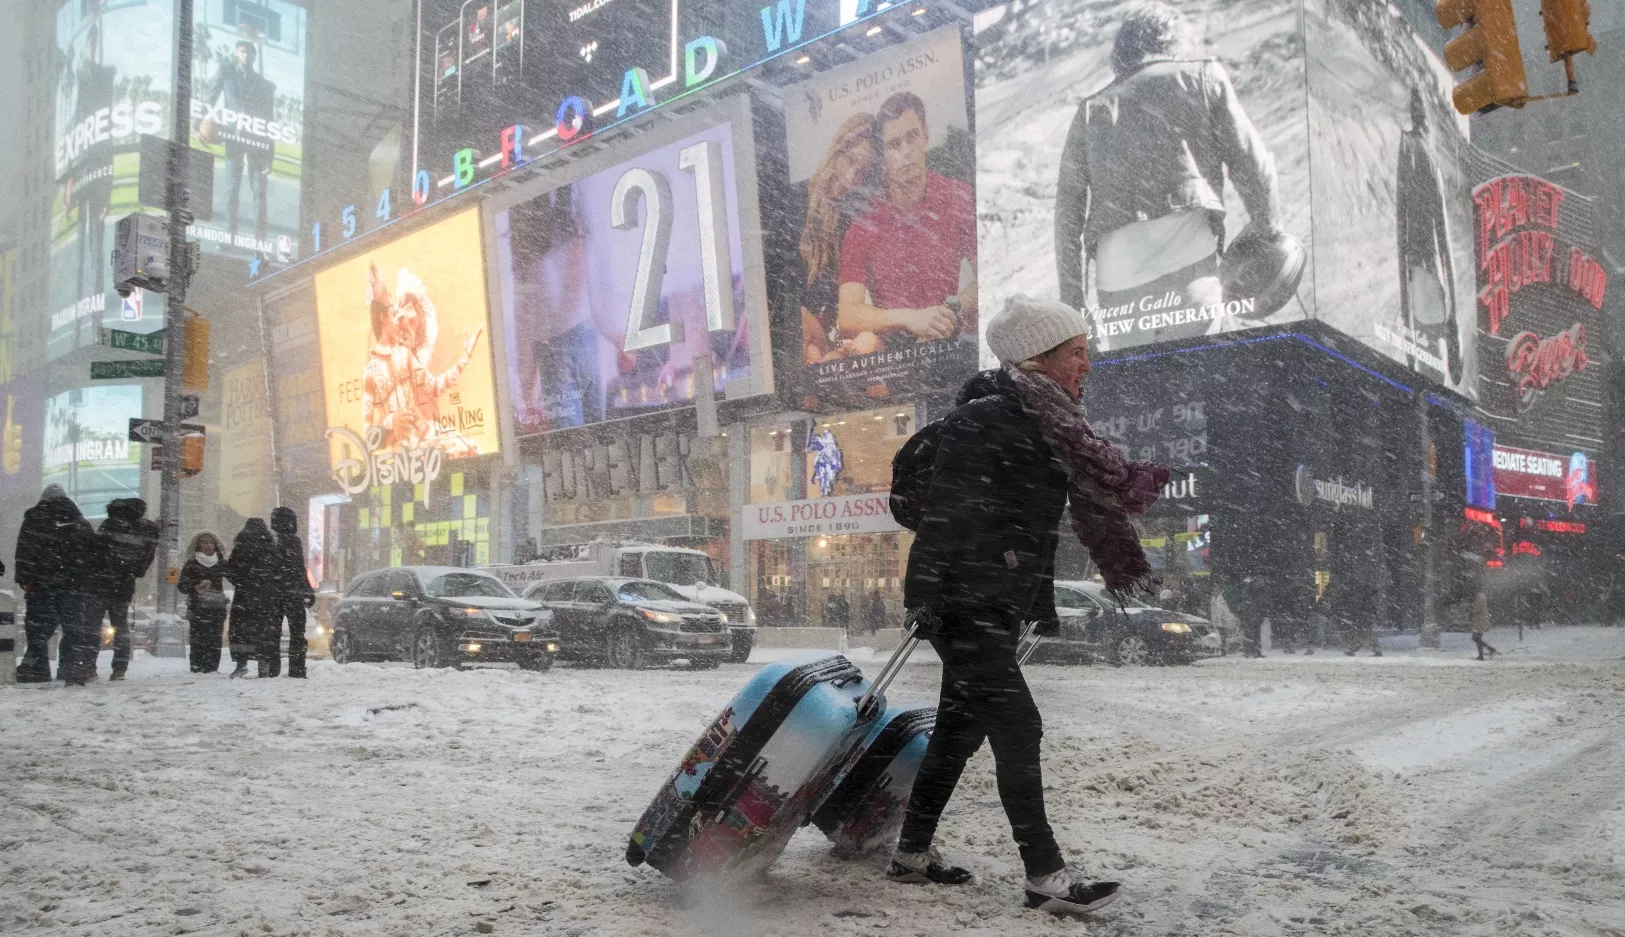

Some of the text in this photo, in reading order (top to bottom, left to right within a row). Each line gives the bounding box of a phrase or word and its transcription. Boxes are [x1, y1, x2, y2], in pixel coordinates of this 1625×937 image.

[568, 0, 612, 22] TIDAL.CO
[828, 51, 940, 102] U.S. POLO ASSN.
[190, 98, 297, 145] EXPRESS
[55, 100, 163, 180] EXPRESS
[1473, 173, 1566, 271] PLANET
[234, 234, 273, 254] INGRAM
[610, 138, 728, 353] 21
[1080, 290, 1183, 322] Vincent Gallo
[1096, 318, 1136, 340] NEW
[1137, 297, 1257, 332] GENERATION
[114, 332, 127, 347] W
[132, 336, 148, 350] 45
[819, 362, 844, 375] LIVE
[851, 339, 962, 370] AUTHENTICALLY
[448, 391, 462, 405] THE
[457, 406, 485, 433] KING
[76, 439, 128, 461] INGRAM
[1527, 454, 1563, 478] SEATING
[1315, 479, 1357, 512] sunglass
[758, 505, 787, 524] U.S.
[790, 500, 837, 522] POLO
[786, 524, 823, 534] SINCE
[503, 570, 545, 582] Tech Air
